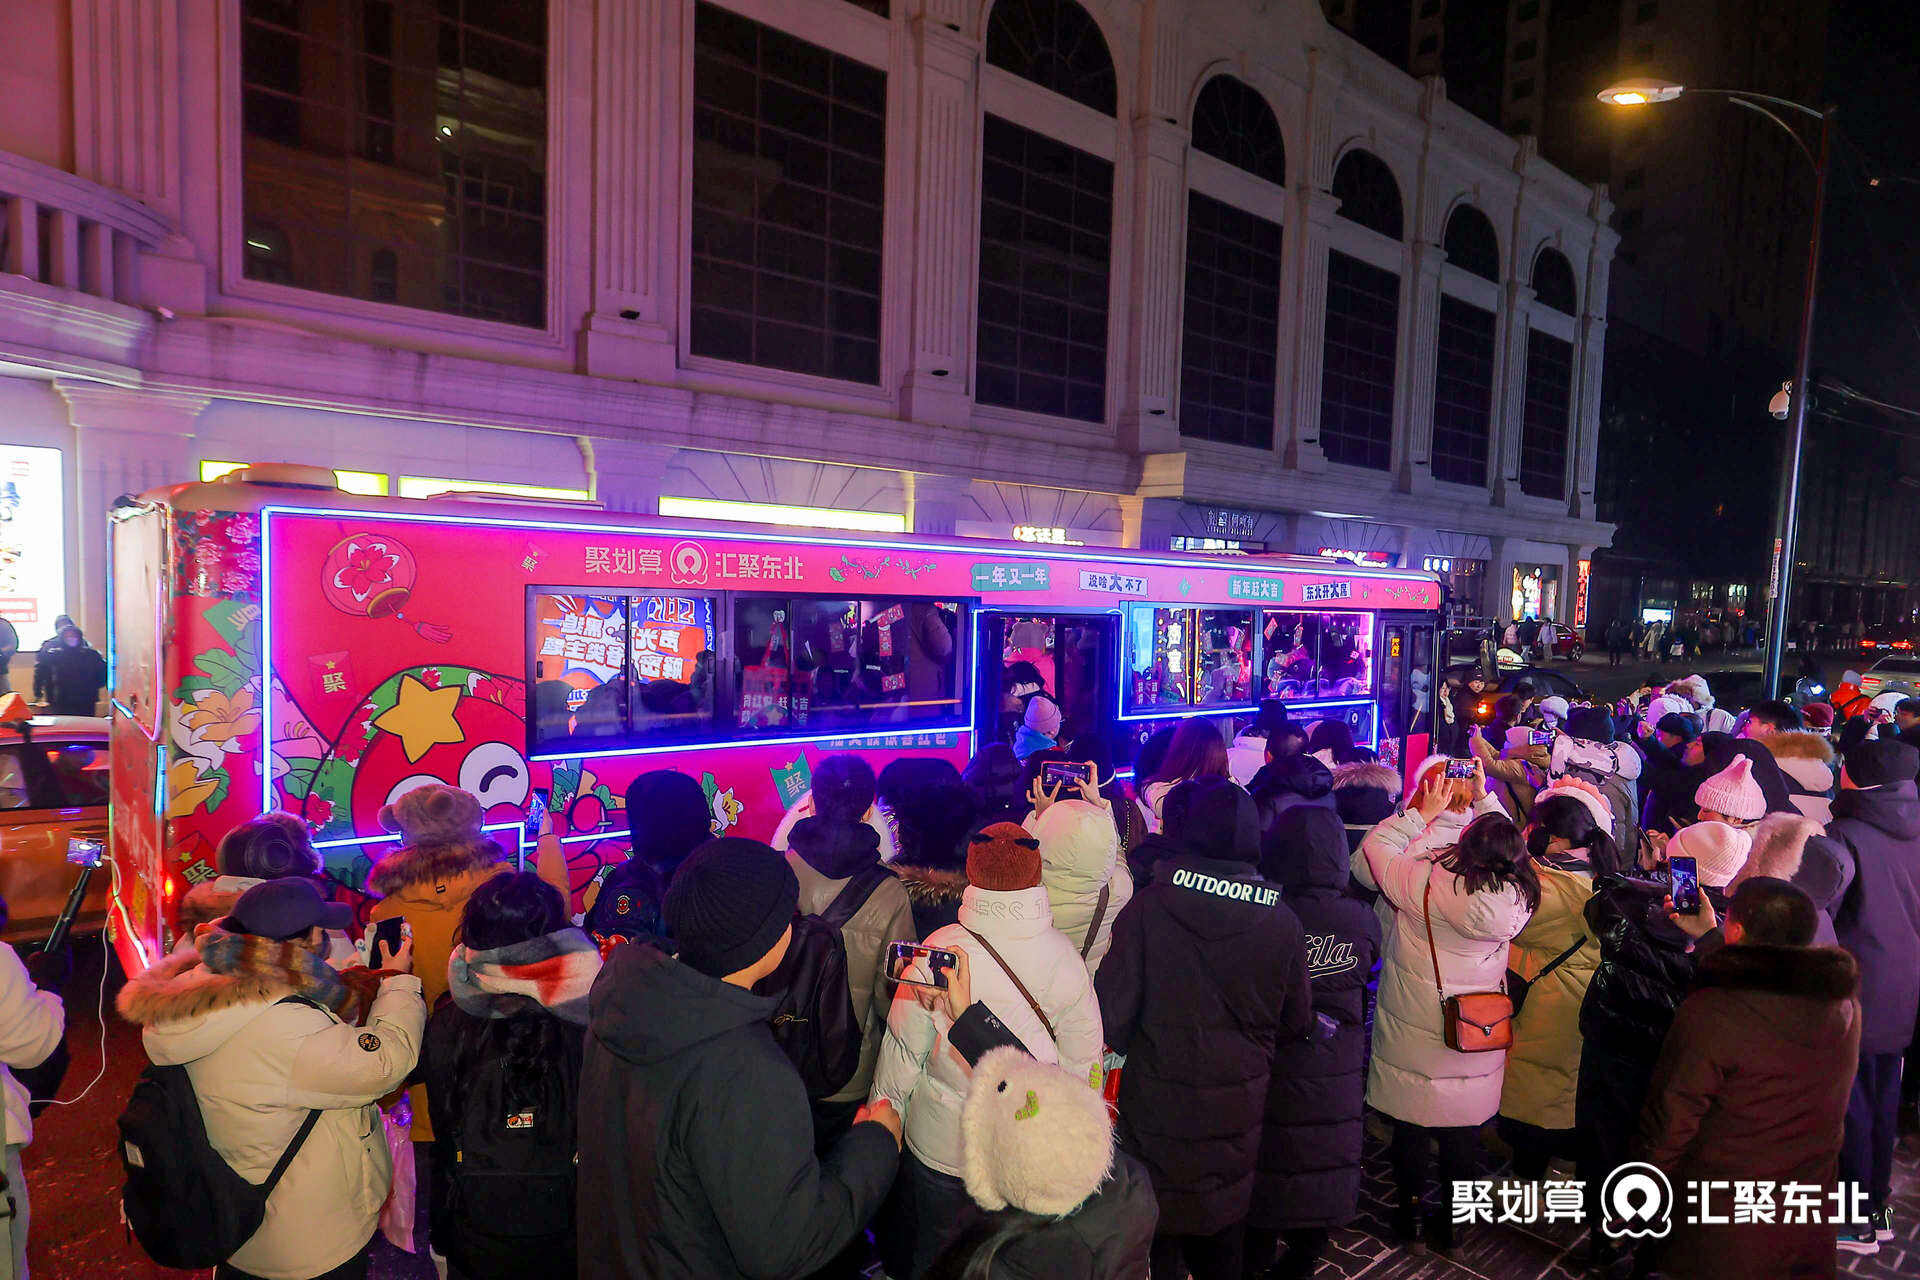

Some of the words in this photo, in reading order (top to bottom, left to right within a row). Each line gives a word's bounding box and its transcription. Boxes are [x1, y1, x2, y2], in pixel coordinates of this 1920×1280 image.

[585, 546, 662, 575] 聚划算
[715, 552, 804, 580] 汇聚东北
[976, 566, 1047, 587] 一年又一年
[1088, 574, 1142, 592] 没啥大不了
[322, 672, 347, 693] 聚
[784, 771, 807, 797] 聚
[1172, 868, 1251, 903] OUTDOOR
